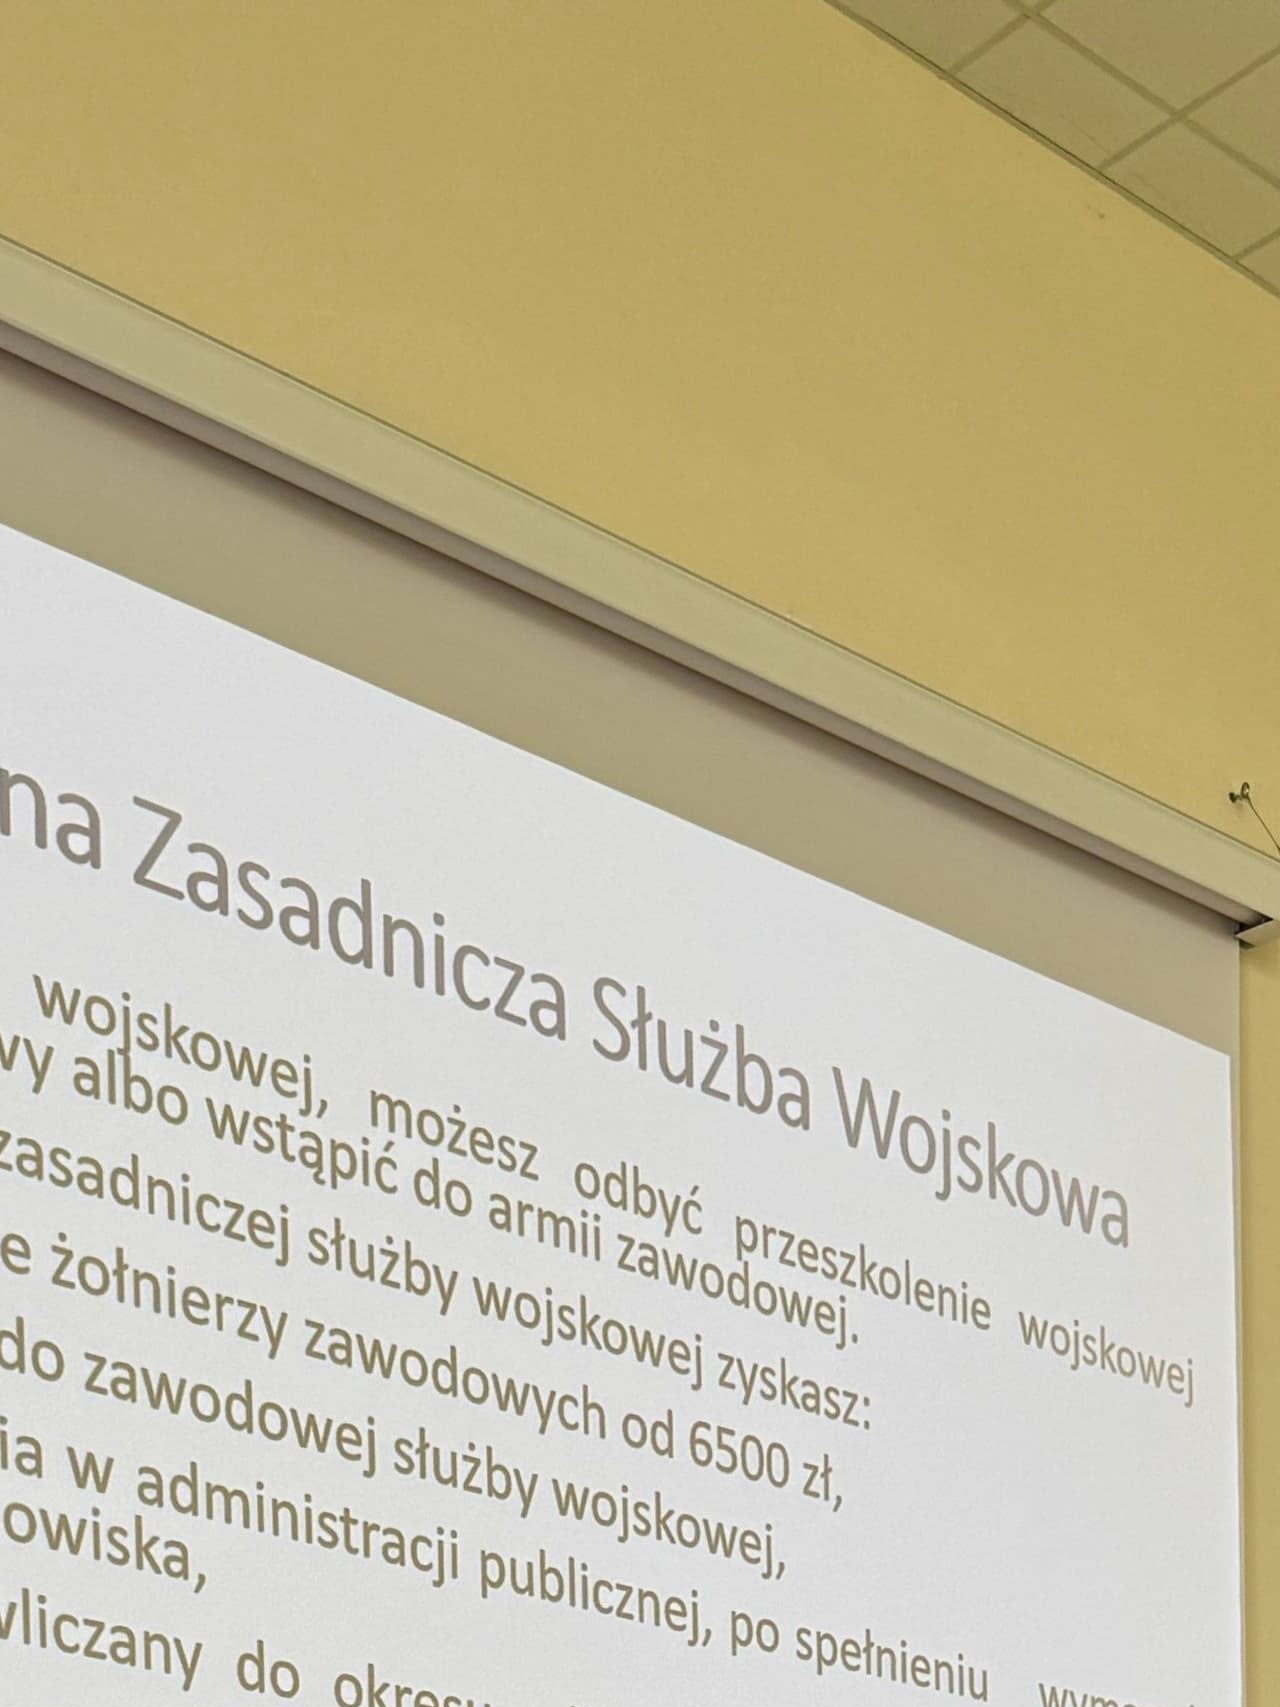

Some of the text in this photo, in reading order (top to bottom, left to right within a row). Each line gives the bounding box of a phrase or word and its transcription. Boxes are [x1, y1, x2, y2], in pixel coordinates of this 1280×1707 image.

[132, 795, 567, 1042] Zasadnicza
[592, 976, 810, 1132] Służba
[831, 1065, 1129, 1249] Wojskowa
[31, 973, 328, 1120] wojskowej,
[369, 1089, 540, 1182] możesz
[574, 1160, 703, 1238] odbyć
[735, 1215, 991, 1331] przeszkolenie
[1018, 1311, 1193, 1409] wojskowej
[72, 1047, 189, 1126] albo
[204, 1096, 399, 1195] wstąpić
[412, 1156, 473, 1218] do
[488, 1192, 601, 1263] armii
[616, 1233, 859, 1351] zawodowej.
[307, 1216, 459, 1317] służby
[471, 1275, 703, 1392] wojskowej
[717, 1352, 871, 1431] zyskasz:
[50, 1231, 289, 1361] żołnierzy
[304, 1318, 607, 1440] zawodowych
[621, 1408, 675, 1459] od
[688, 1420, 790, 1489] 6500
[802, 1453, 843, 1513] zł,
[83, 1351, 377, 1479] zawodowej
[393, 1426, 539, 1520] służby
[551, 1477, 786, 1581] wojskowej,
[65, 1445, 115, 1495] w
[136, 1460, 459, 1589] administracji
[480, 1548, 713, 1648] publicznej,
[730, 1610, 780, 1657] po
[795, 1627, 988, 1703] spełnieniu
[236, 1639, 300, 1699] do
